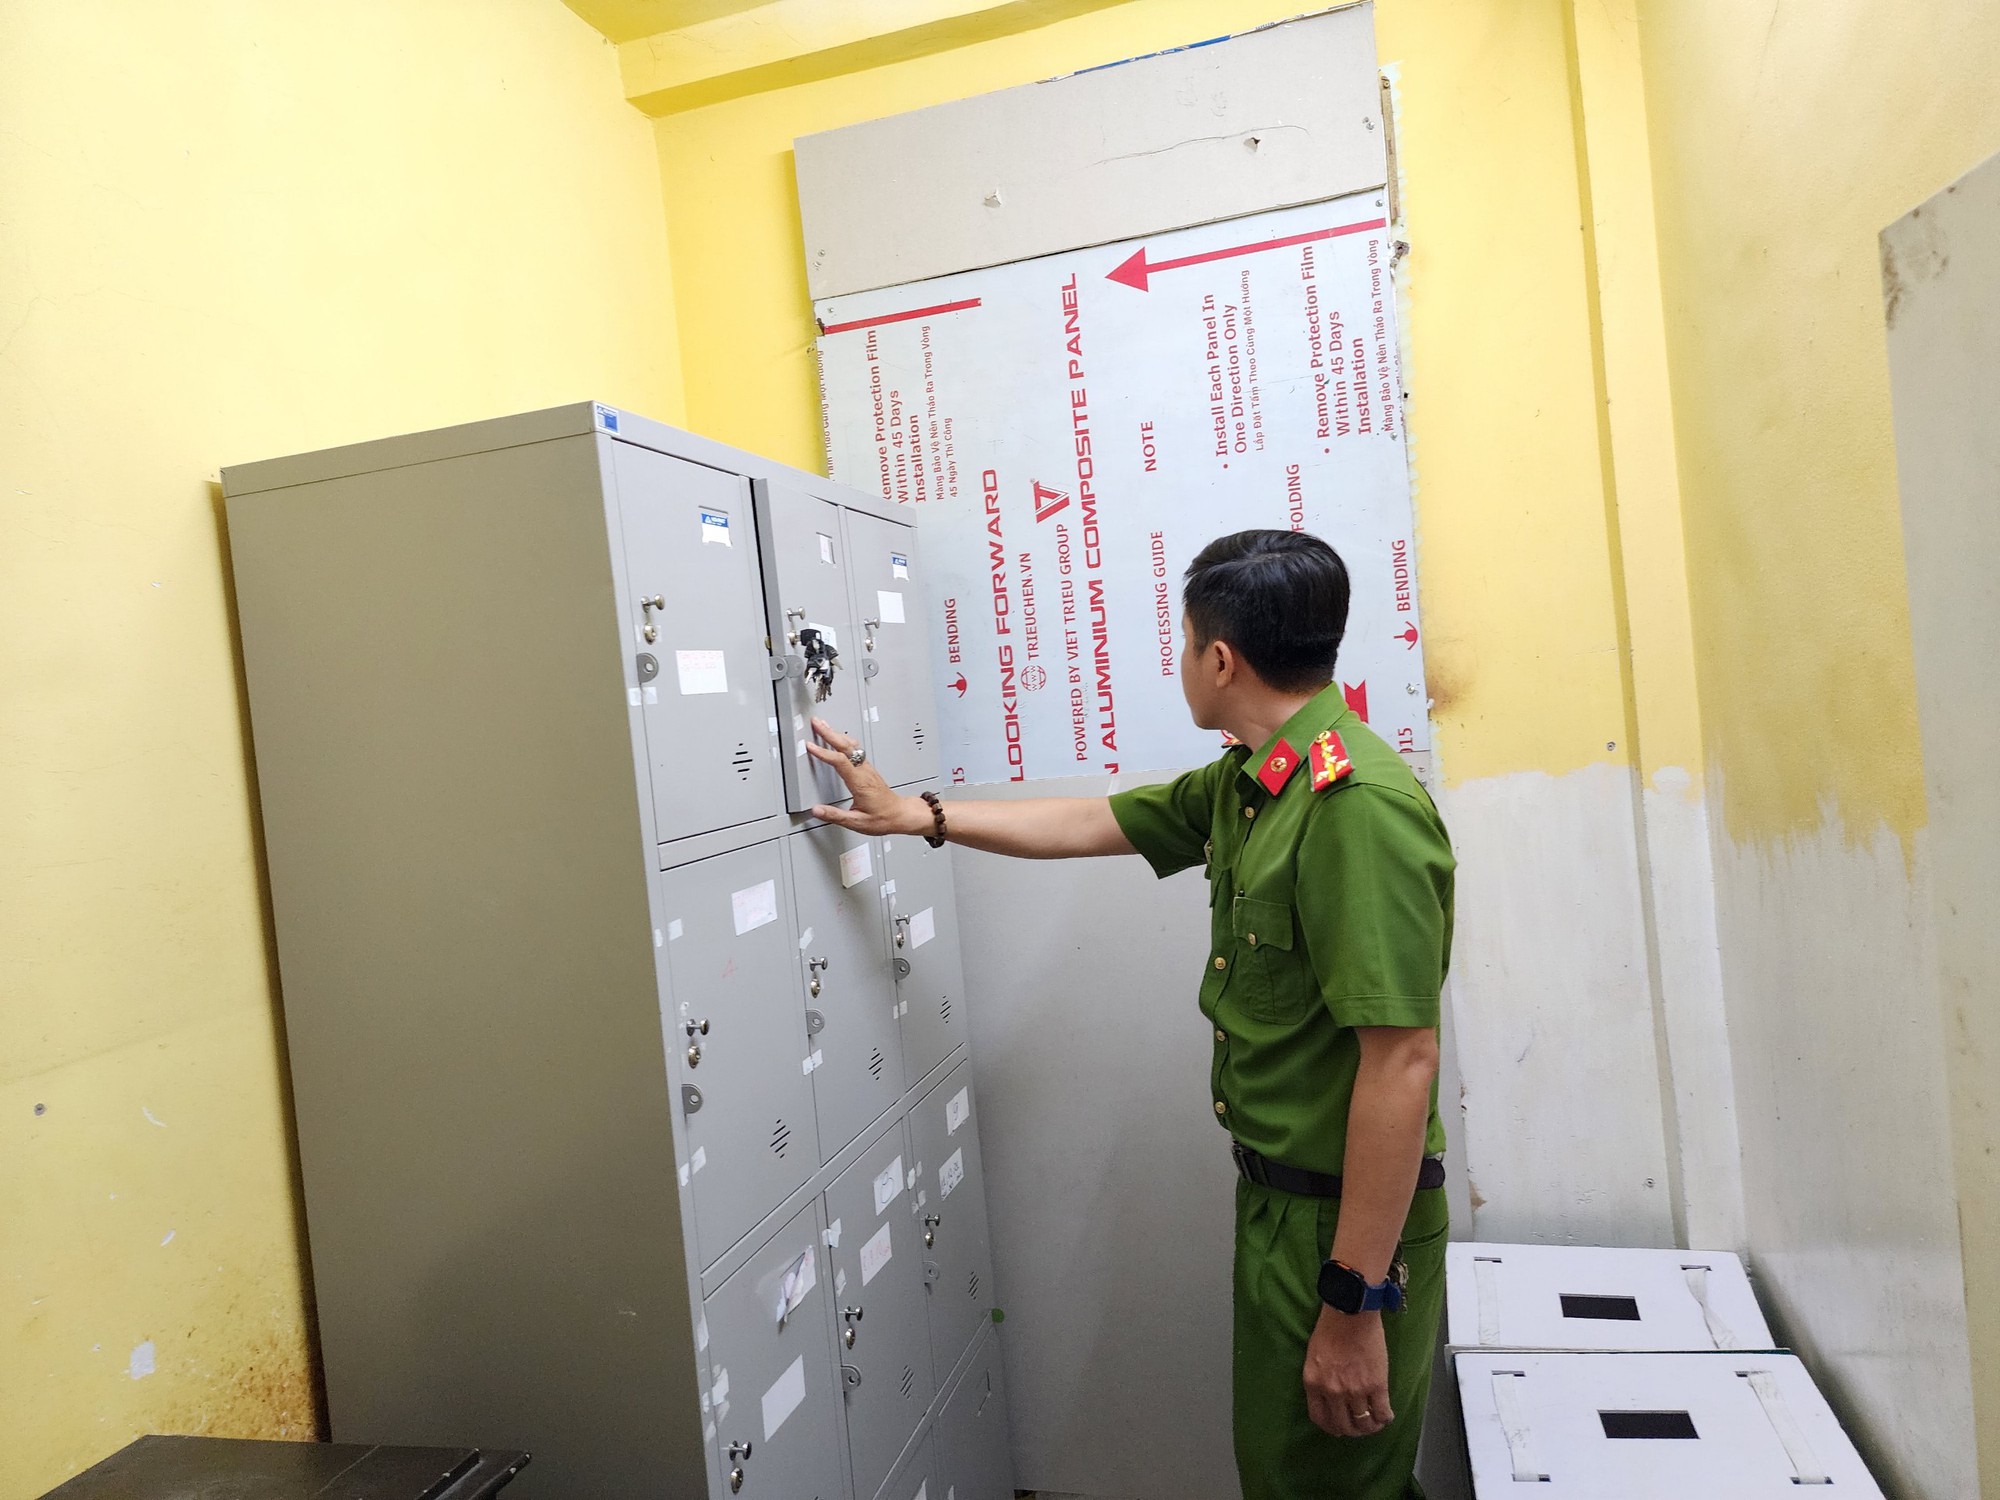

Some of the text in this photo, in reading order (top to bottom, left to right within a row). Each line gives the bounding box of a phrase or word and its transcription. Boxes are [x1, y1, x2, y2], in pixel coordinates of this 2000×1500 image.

[1367, 240, 1378, 267] Vòng
[1371, 268, 1381, 298] Trong
[921, 325, 930, 350] Vòng
[1374, 300, 1382, 314] Ra
[1375, 316, 1384, 342] Tháo
[866, 329, 879, 361] Film
[924, 351, 932, 379] Trong
[1202, 294, 1228, 456] Install Each Panel In
[1249, 358, 1258, 383] Theo
[1301, 246, 1330, 438] Remove Protection Film
[1330, 311, 1350, 436] Within 45 Days
[1376, 344, 1386, 364] Nên
[870, 365, 886, 442] Protection
[926, 381, 934, 393] Ra
[926, 395, 936, 418] Tháo
[1223, 305, 1247, 453] One Direction Only
[1352, 338, 1372, 435] Installation
[890, 390, 909, 504] Within 45 Days
[909, 414, 926, 502] Installation
[929, 420, 938, 439] Nên
[944, 418, 958, 497] 45 Ngày Thi Công
[1140, 420, 1157, 472] NOTE
[936, 475, 944, 500] Màng
[1061, 272, 1117, 752] ALUMINIUM COMPOSITE PANEL
[1286, 464, 1304, 533] FOLDING
[1018, 552, 1040, 660] TRIEUCHEN.VN
[1151, 531, 1174, 676] PROCESSING GUIDE
[1392, 539, 1411, 612] BENDING
[944, 598, 962, 664] BENDING
[982, 469, 1024, 783] LOOKING FORWARD
[1056, 524, 1088, 760] POWERED BY VIET TRIEU GROUP
